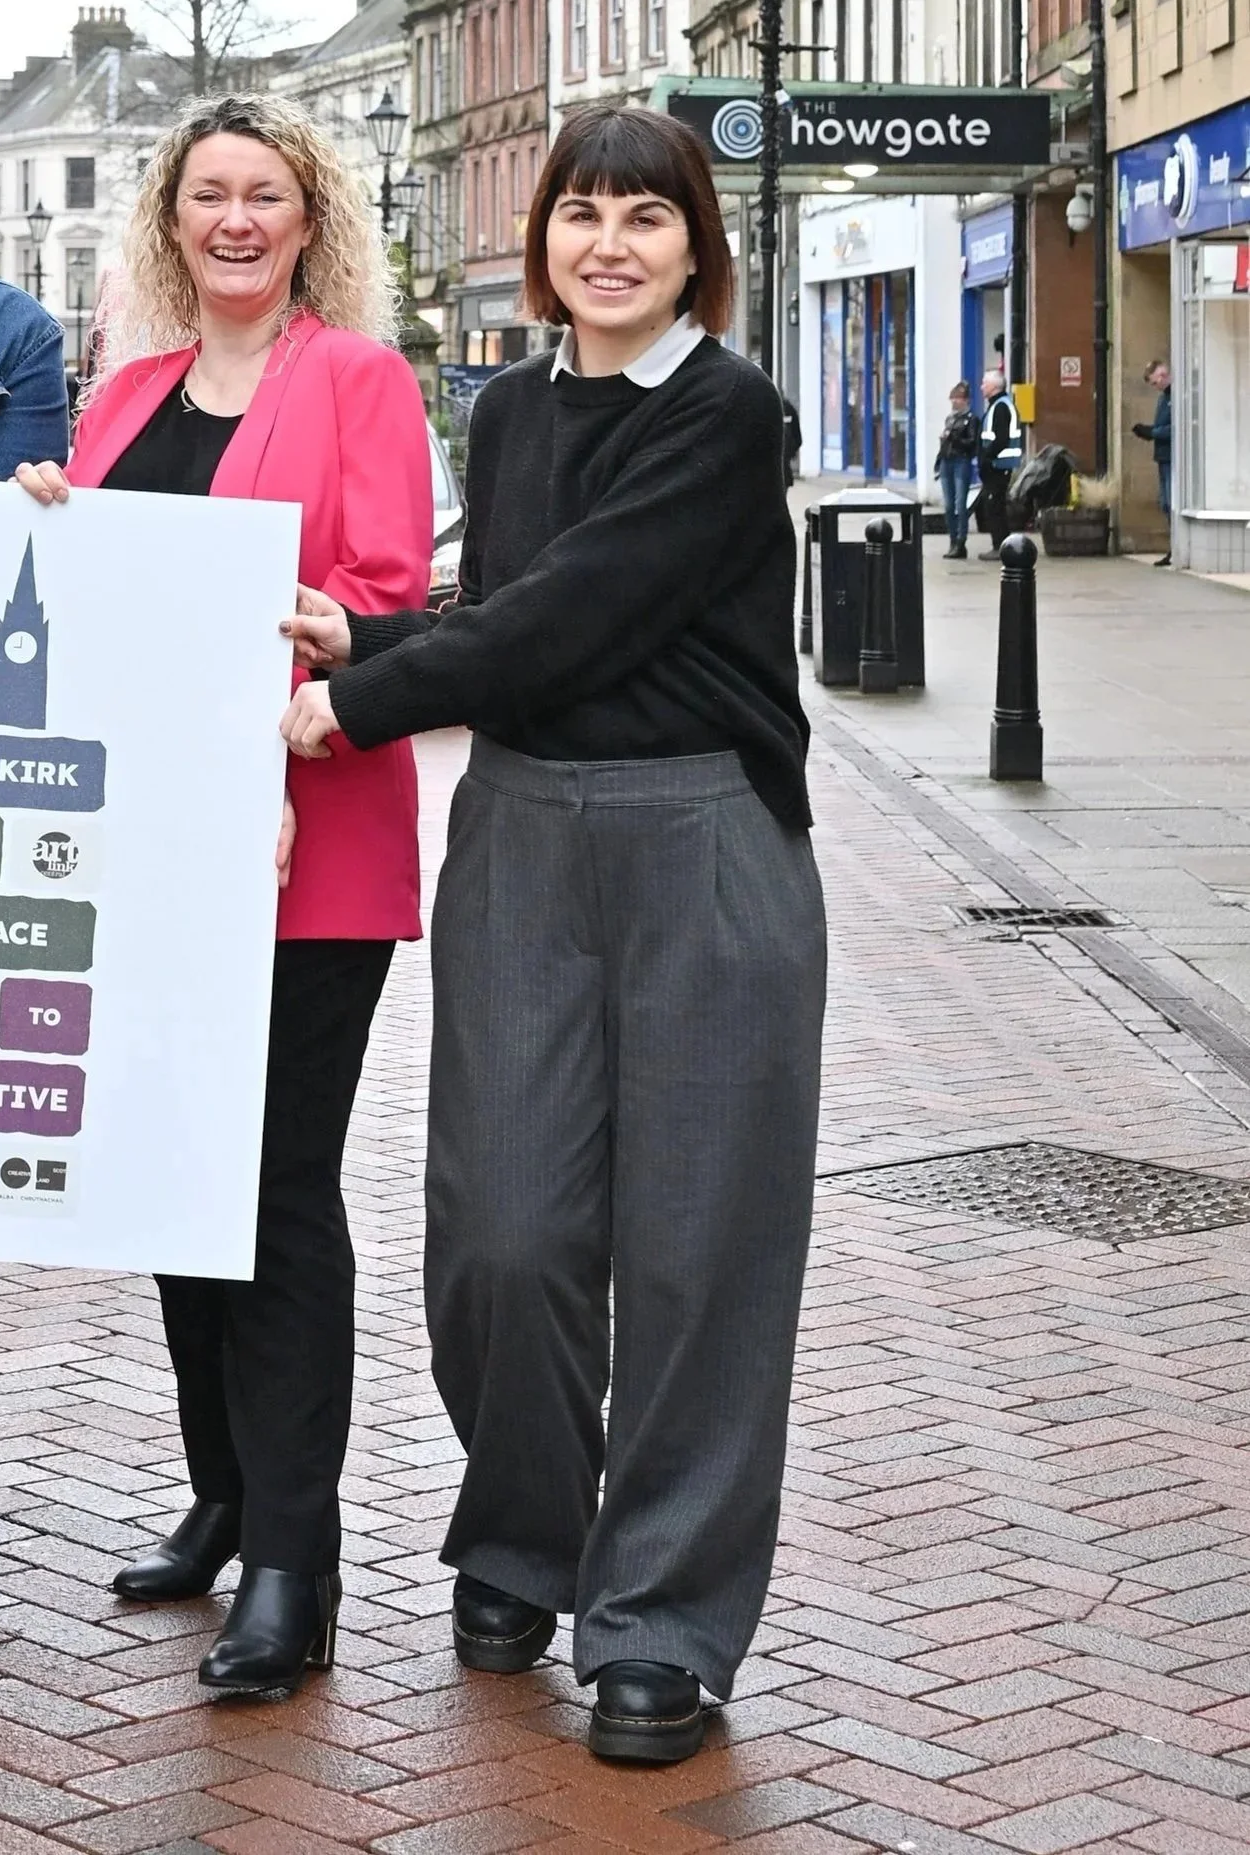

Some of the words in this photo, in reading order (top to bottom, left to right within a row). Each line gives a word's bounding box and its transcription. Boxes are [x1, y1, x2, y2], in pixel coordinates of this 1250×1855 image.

[803, 100, 837, 114] THE
[790, 112, 992, 158] howgate
[32, 838, 80, 862] art
[48, 860, 77, 873] link
[28, 1007, 61, 1026] TO
